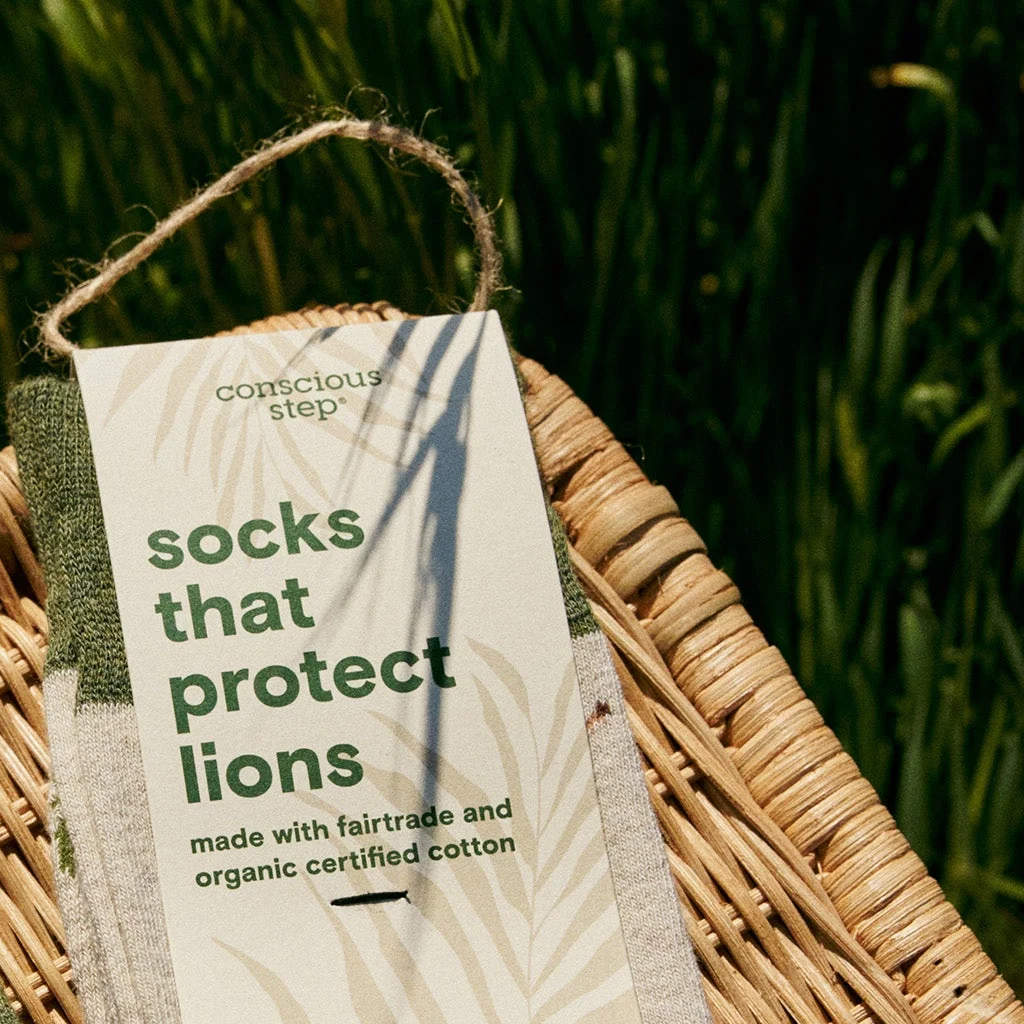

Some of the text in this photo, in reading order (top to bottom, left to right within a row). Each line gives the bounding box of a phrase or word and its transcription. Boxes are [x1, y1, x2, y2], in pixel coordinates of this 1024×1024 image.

[215, 370, 382, 402] conscious
[148, 501, 364, 569] socks
[155, 579, 315, 642] that
[169, 636, 457, 735] protect
[180, 742, 363, 803] lions
[191, 798, 512, 854] made with fairtrade and
[196, 838, 515, 889] organic certified cotton
